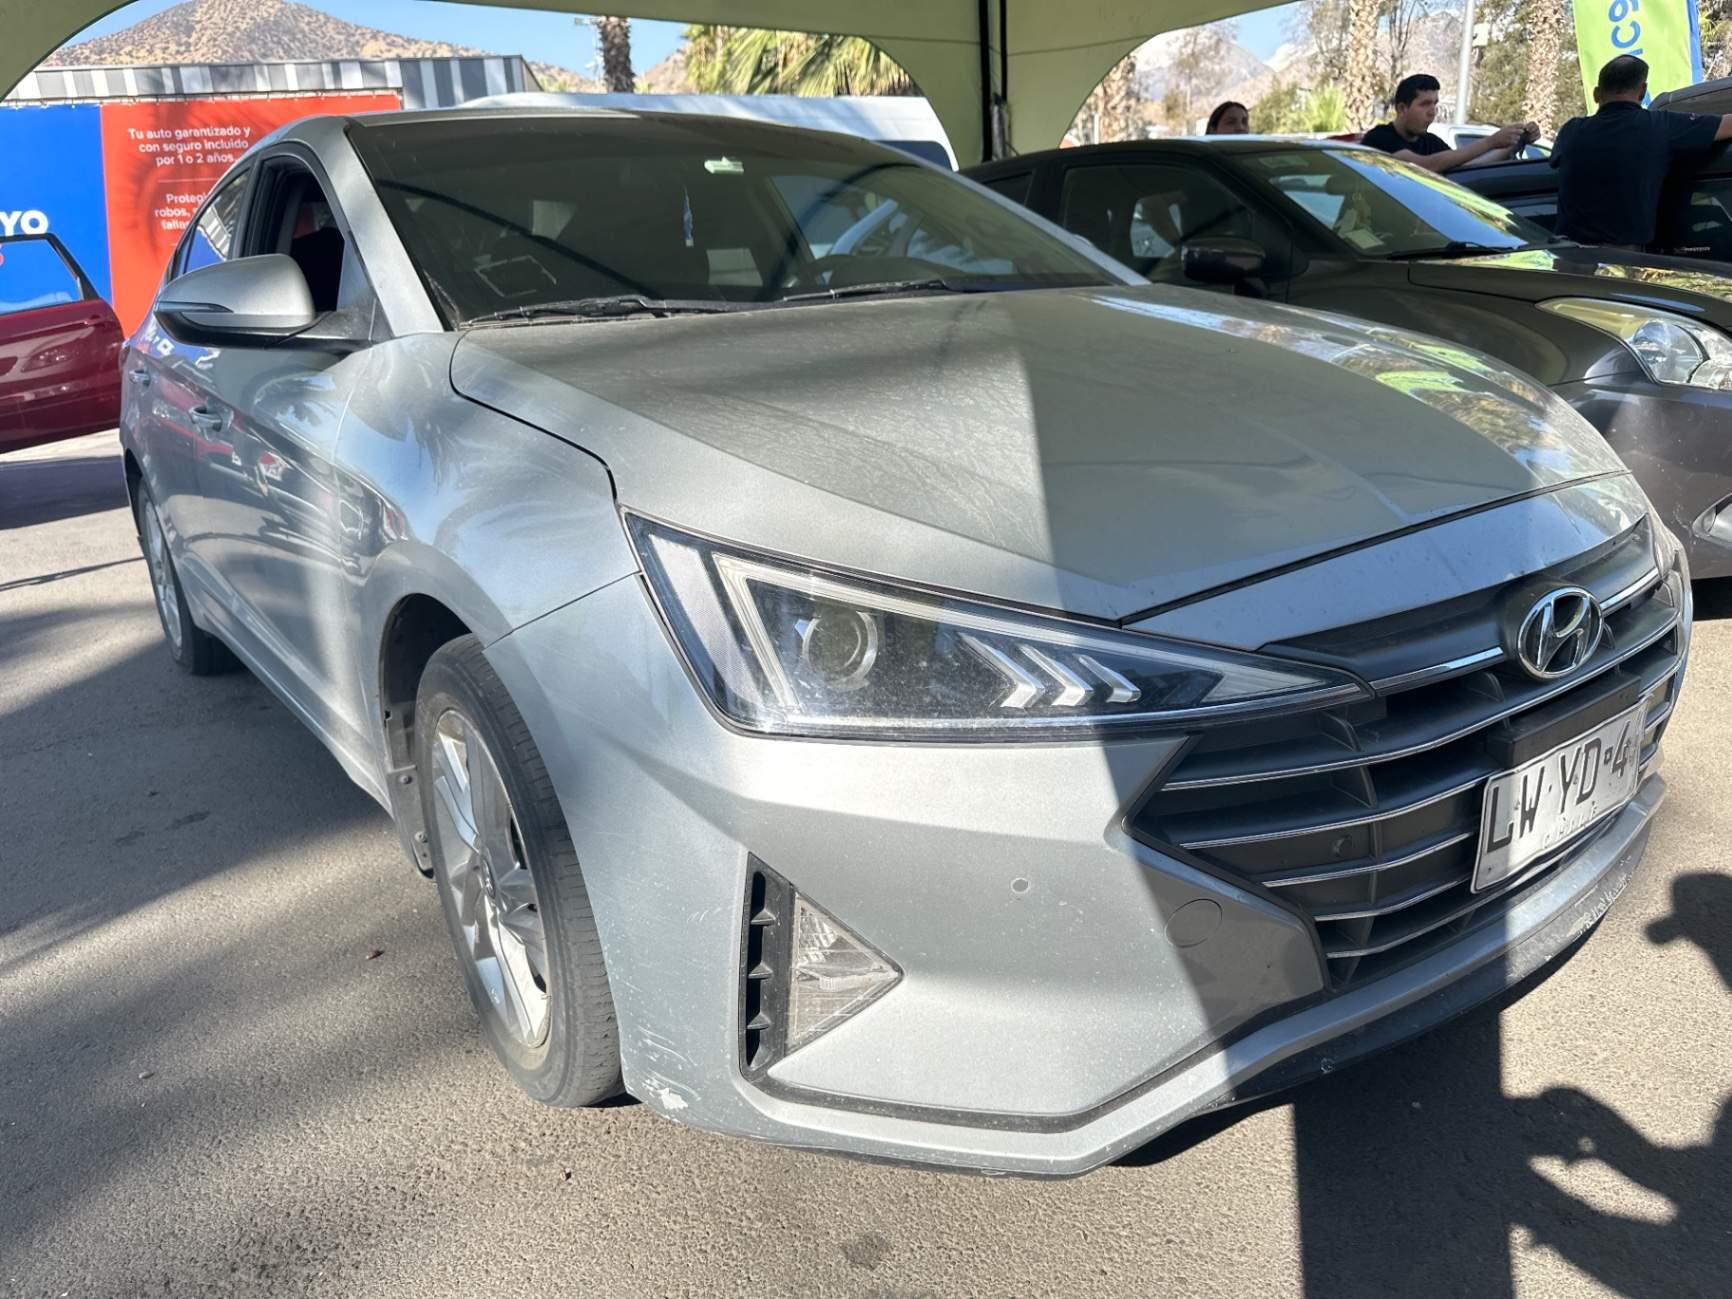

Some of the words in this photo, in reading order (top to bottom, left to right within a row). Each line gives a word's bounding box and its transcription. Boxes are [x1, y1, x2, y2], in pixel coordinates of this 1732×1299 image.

[128, 128, 144, 139] Tu
[147, 129, 172, 139] auto
[175, 127, 241, 139] garantizado
[244, 127, 251, 136] y
[139, 144, 160, 152] con
[163, 142, 202, 153] seguro
[204, 139, 249, 149] incluido
[156, 157, 175, 167] por
[178, 155, 183, 163] 1
[196, 154, 204, 163] 2
[154, 208, 191, 217] robos,
